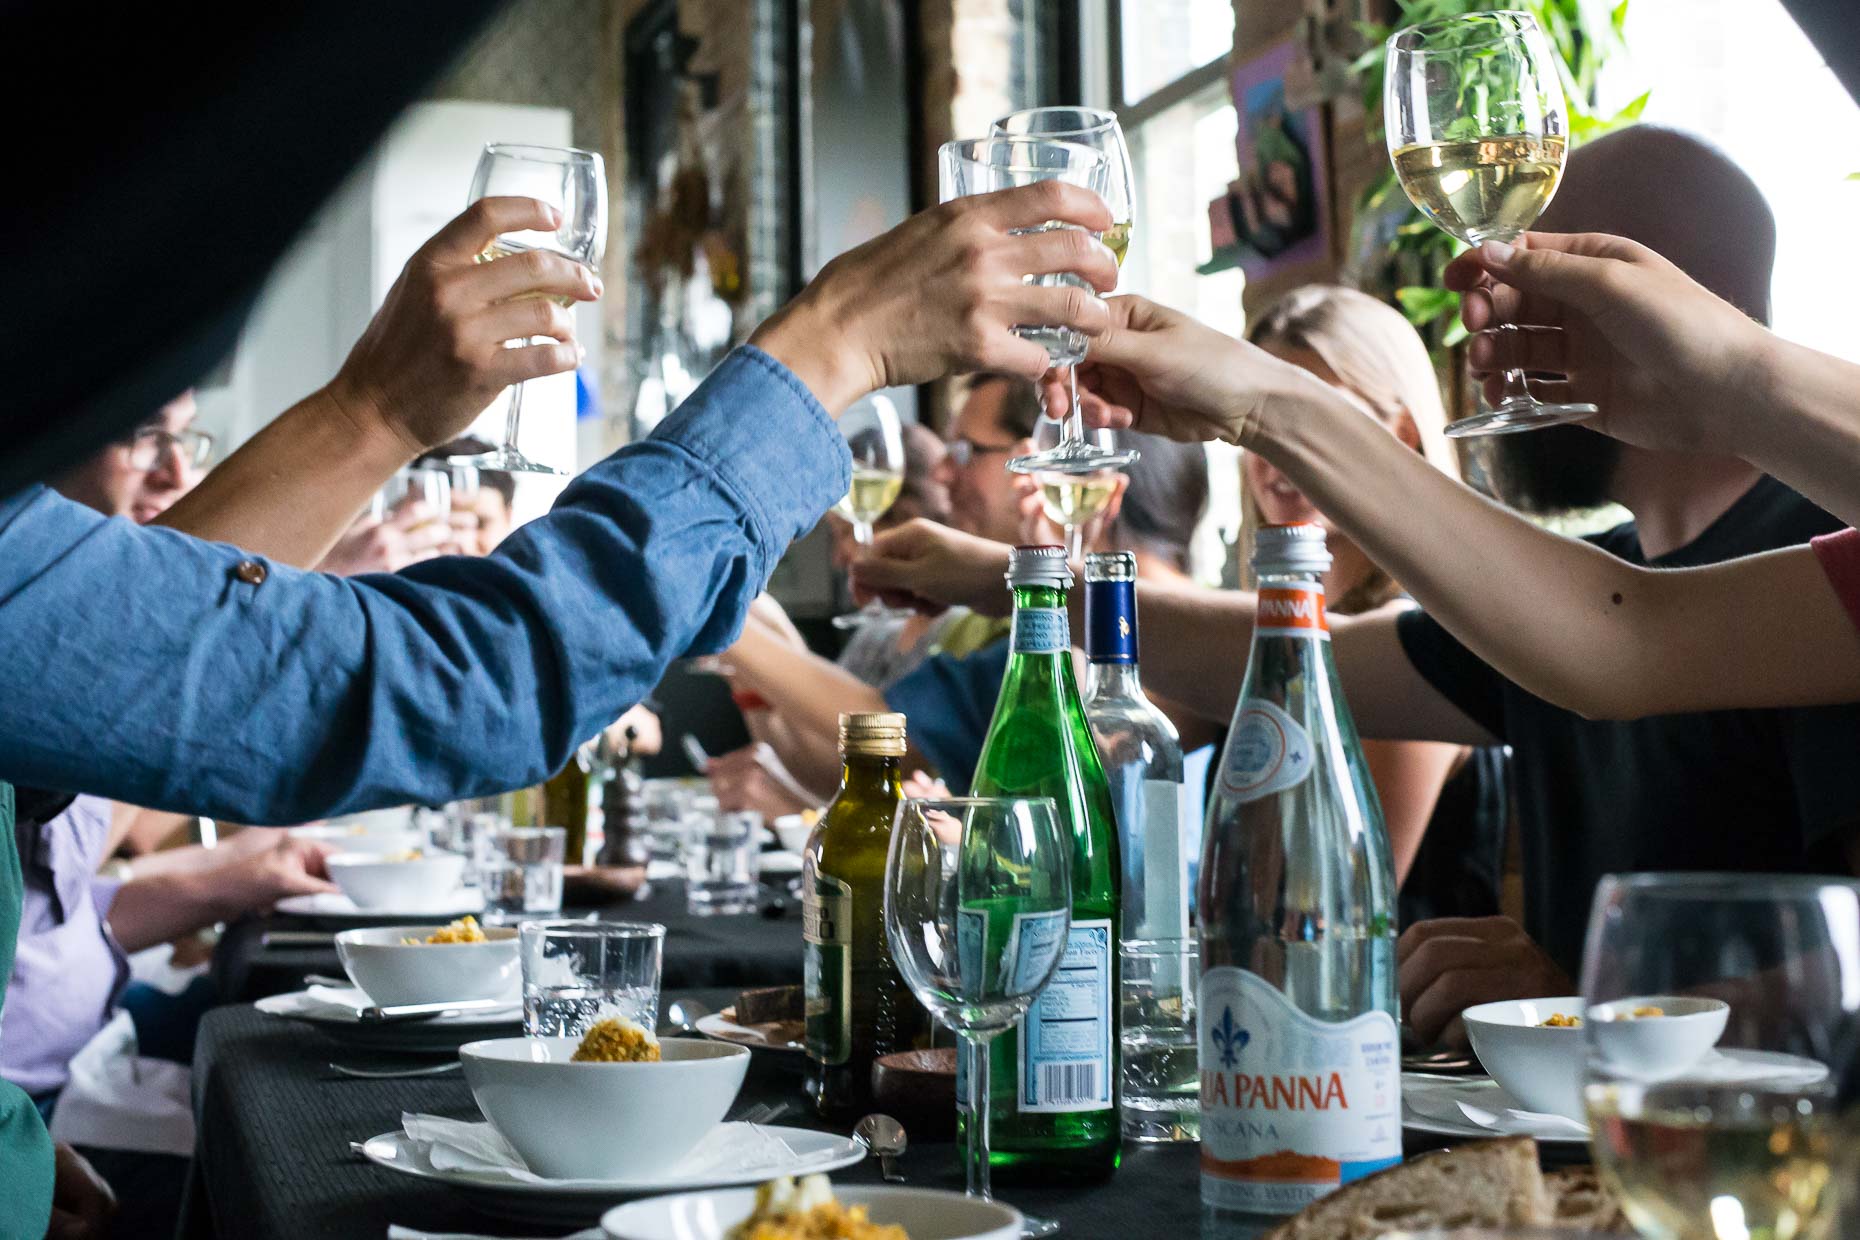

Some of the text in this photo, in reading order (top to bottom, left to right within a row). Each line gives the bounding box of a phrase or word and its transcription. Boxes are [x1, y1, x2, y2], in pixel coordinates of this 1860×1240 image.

[1260, 599, 1313, 619] PANNA
[1201, 1071, 1348, 1111] UA PANNA
